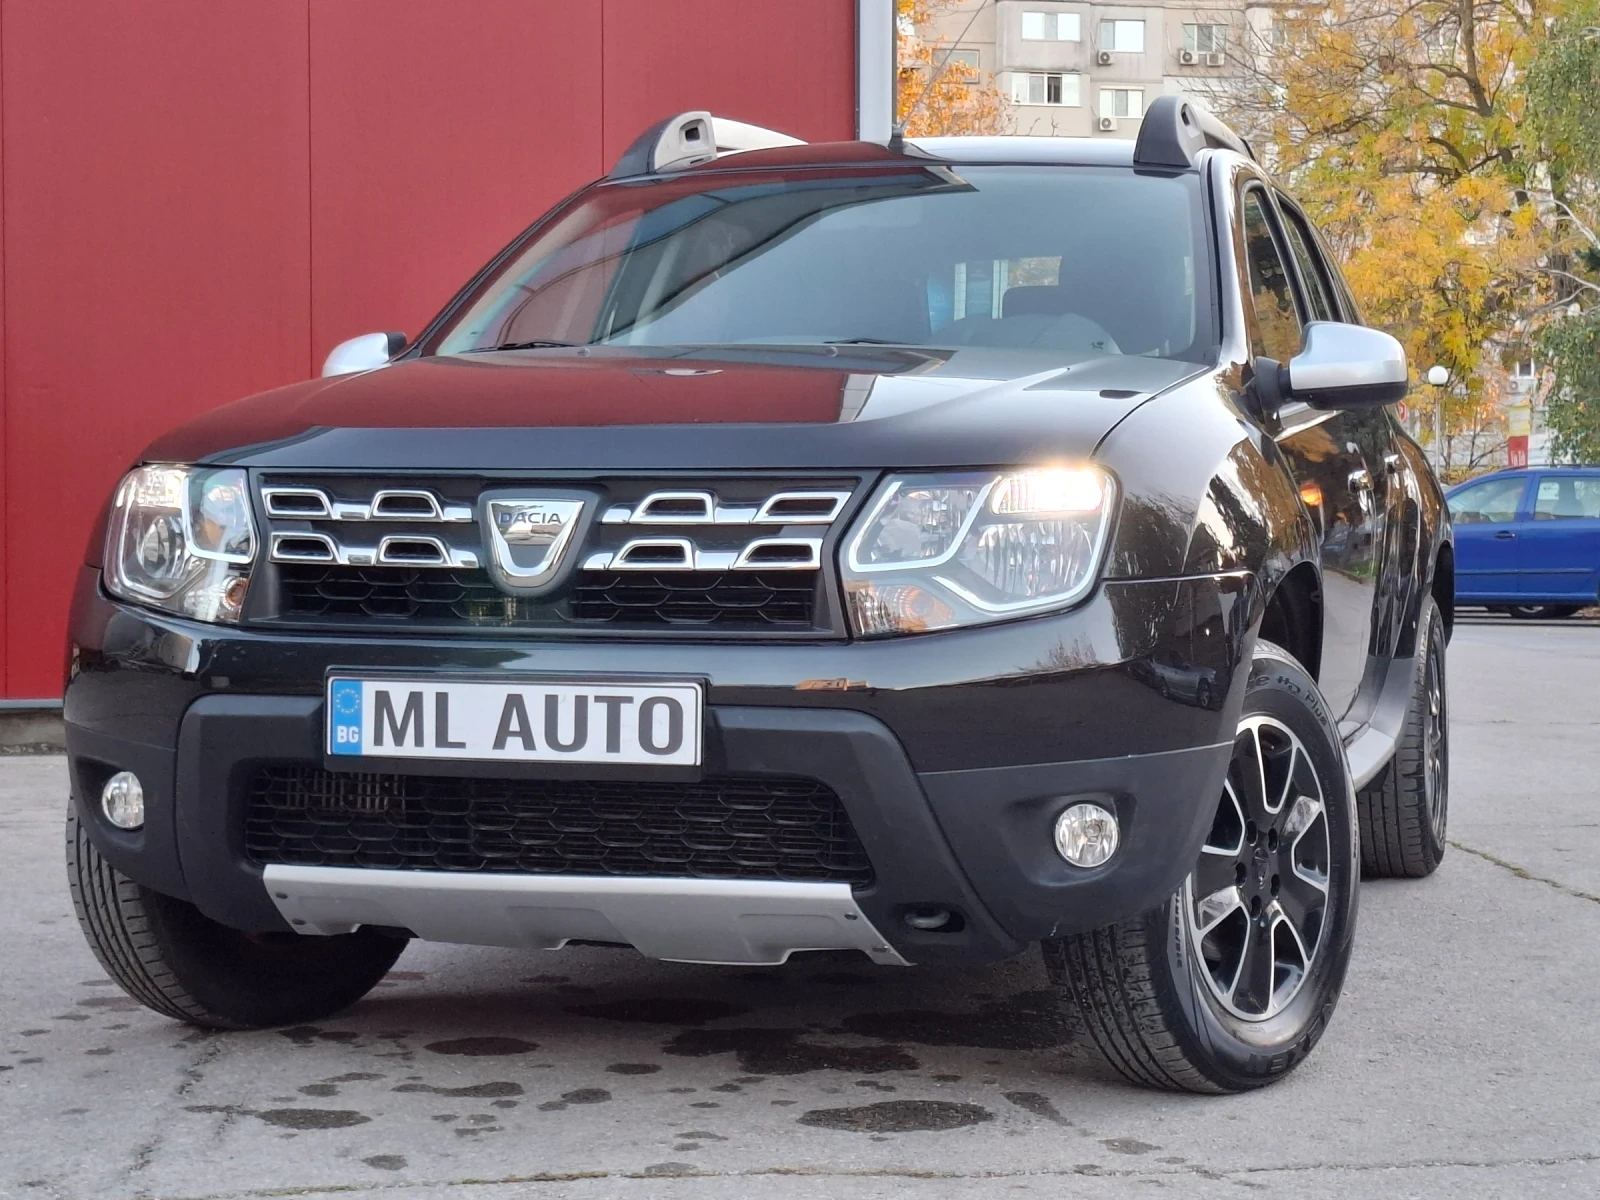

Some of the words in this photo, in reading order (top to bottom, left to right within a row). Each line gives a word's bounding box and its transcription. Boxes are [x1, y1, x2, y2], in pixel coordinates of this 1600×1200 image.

[499, 511, 562, 524] DACIA
[1304, 690, 1327, 726] Plus
[337, 725, 359, 743] BG
[373, 690, 467, 749] ML
[492, 693, 685, 756] AUTO
